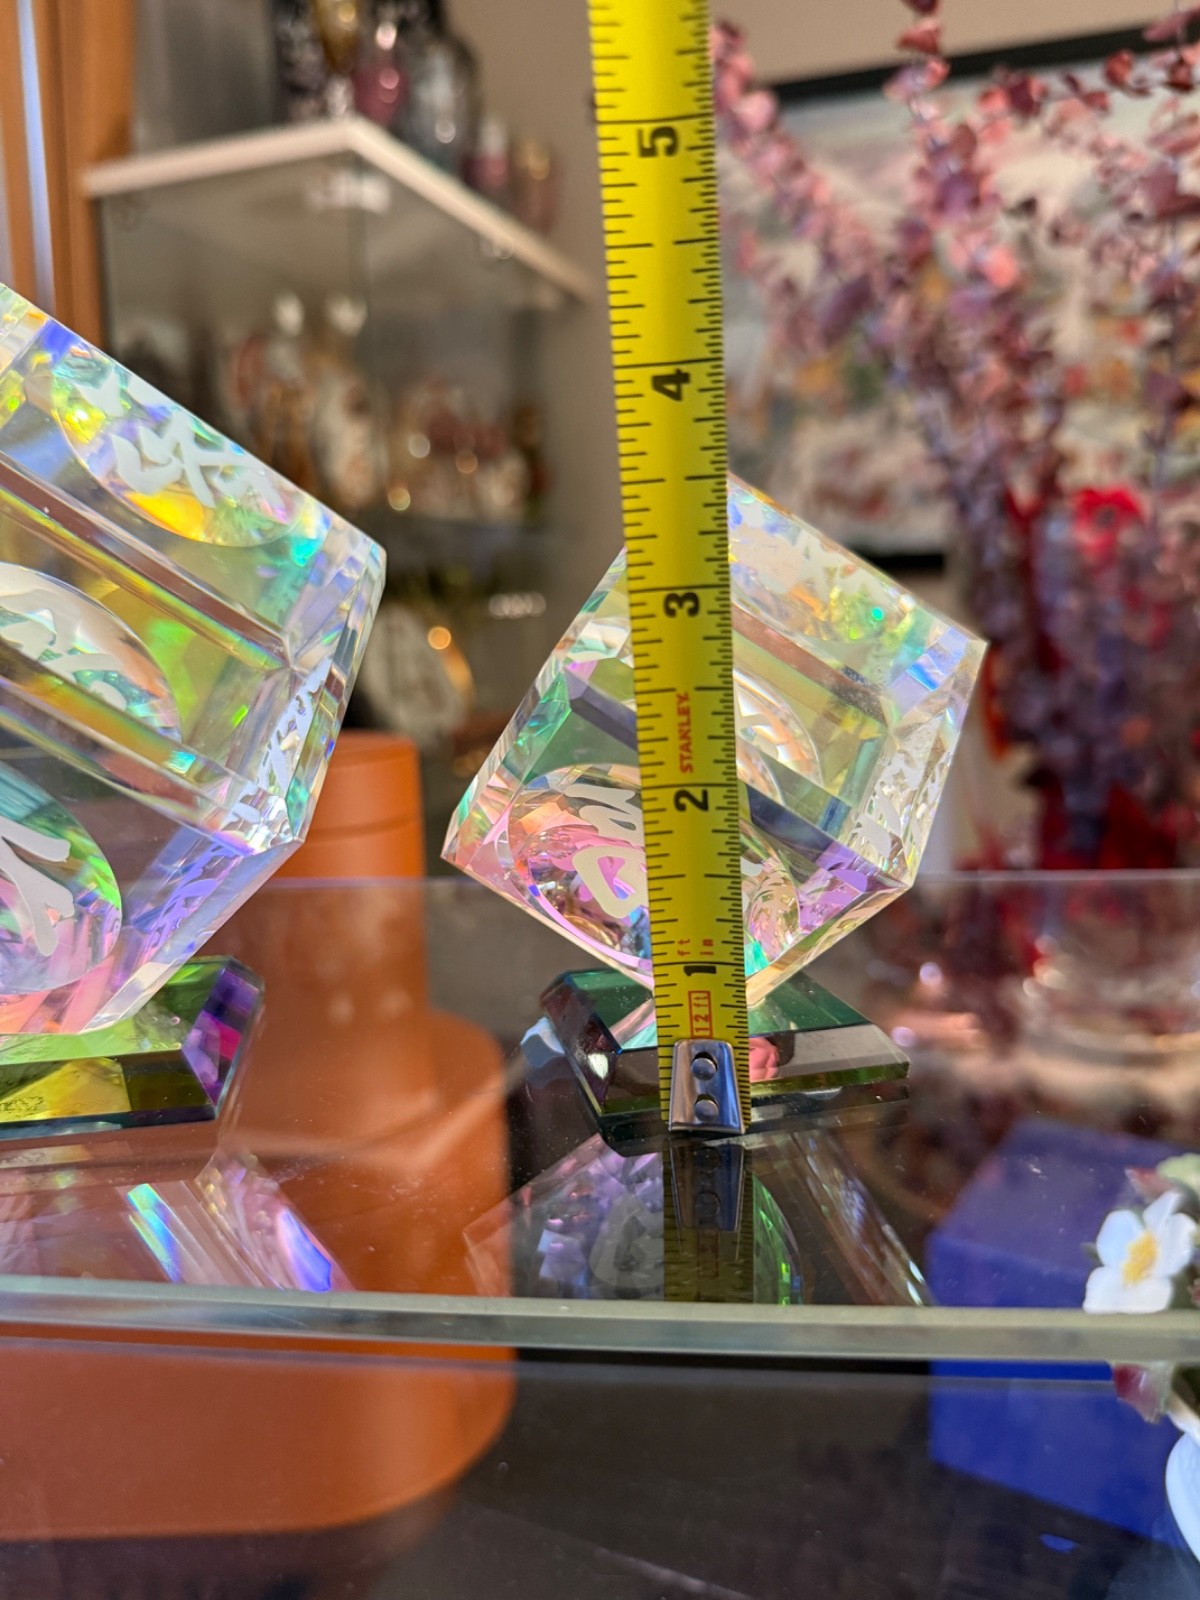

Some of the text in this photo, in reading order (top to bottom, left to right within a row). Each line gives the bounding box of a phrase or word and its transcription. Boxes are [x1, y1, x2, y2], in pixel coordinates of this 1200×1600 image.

[637, 126, 679, 158] 5
[651, 369, 691, 401] 4
[663, 591, 700, 618] 3
[676, 692, 693, 774] STANLEY
[673, 789, 709, 812] 2
[683, 965, 717, 976] 1
[694, 1013, 710, 1033] 12
